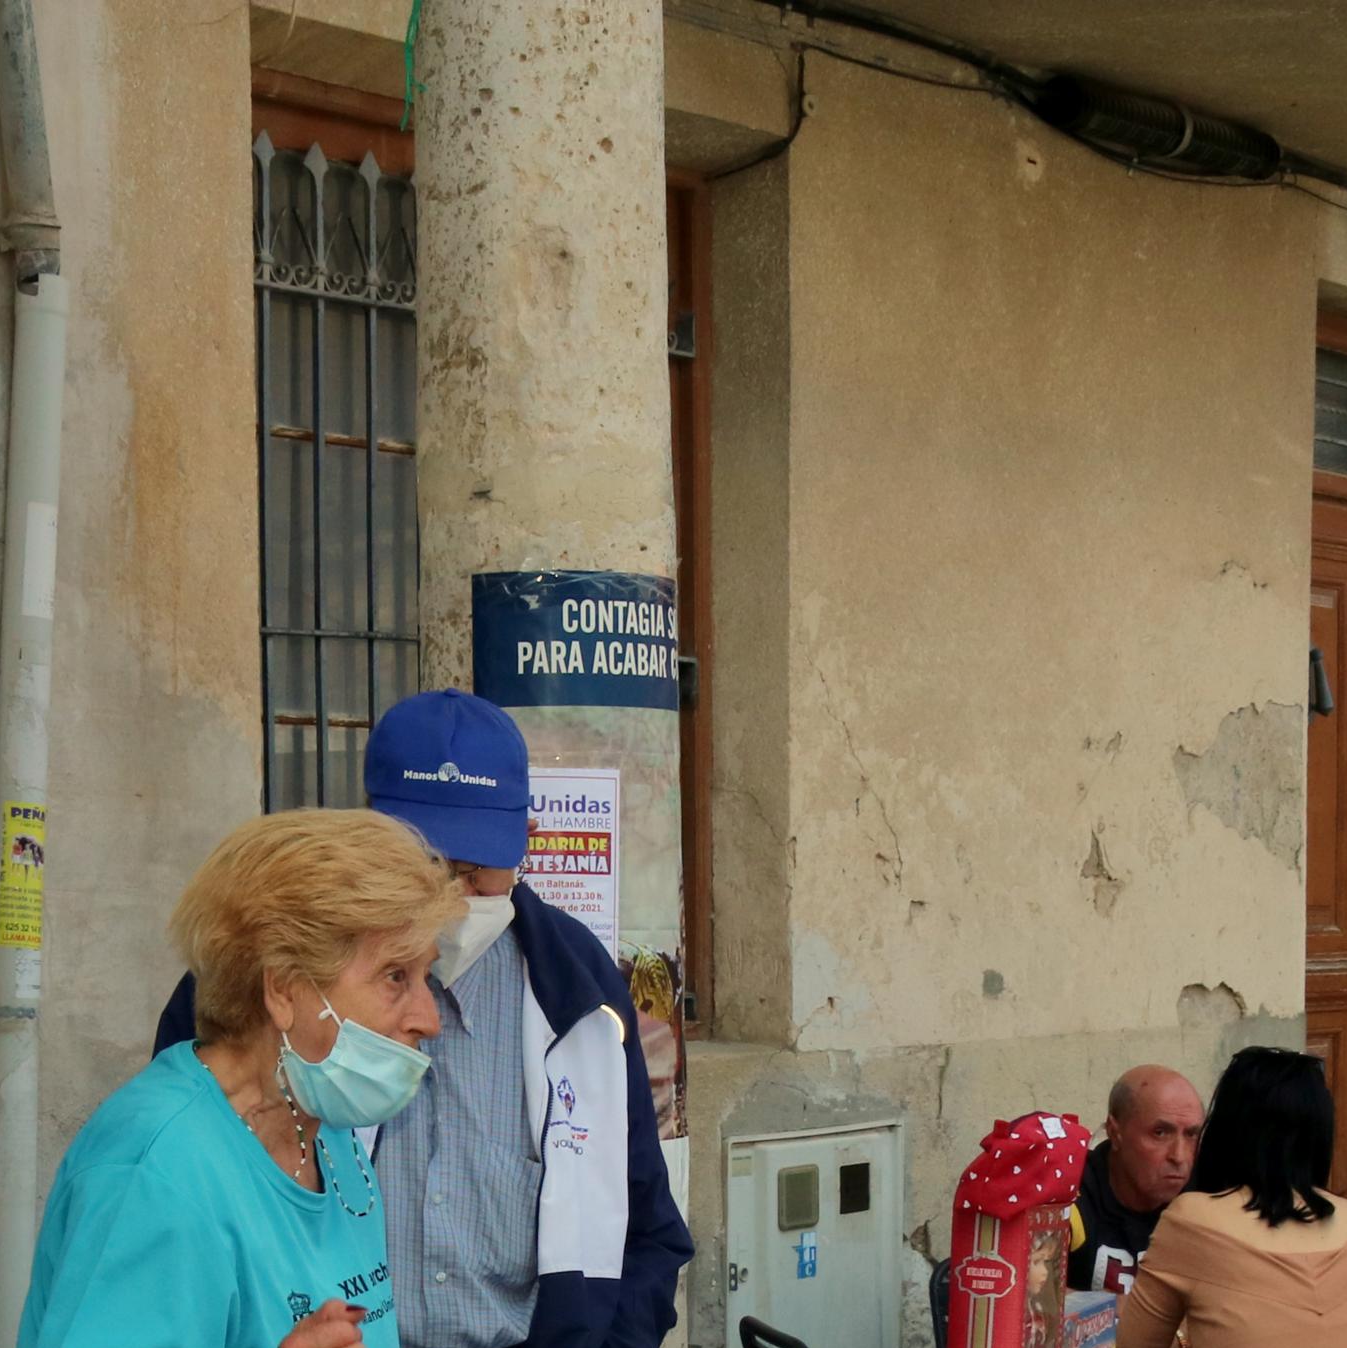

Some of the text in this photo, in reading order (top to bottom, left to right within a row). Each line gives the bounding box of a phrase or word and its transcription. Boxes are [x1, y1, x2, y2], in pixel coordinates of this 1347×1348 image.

[561, 598, 665, 640] CONTAGIA
[517, 640, 668, 678] PARA ACABAR
[403, 769, 497, 788] Manos Unidas
[530, 794, 611, 815] Unidas
[553, 817, 611, 829] HAMBRE
[528, 837, 608, 852] IDARIA DE
[530, 852, 608, 873] TESANÍA
[546, 879, 586, 888] Baltanás.
[568, 904, 578, 912] de
[581, 904, 604, 912] 2021.
[337, 1274, 369, 1300] XXI
